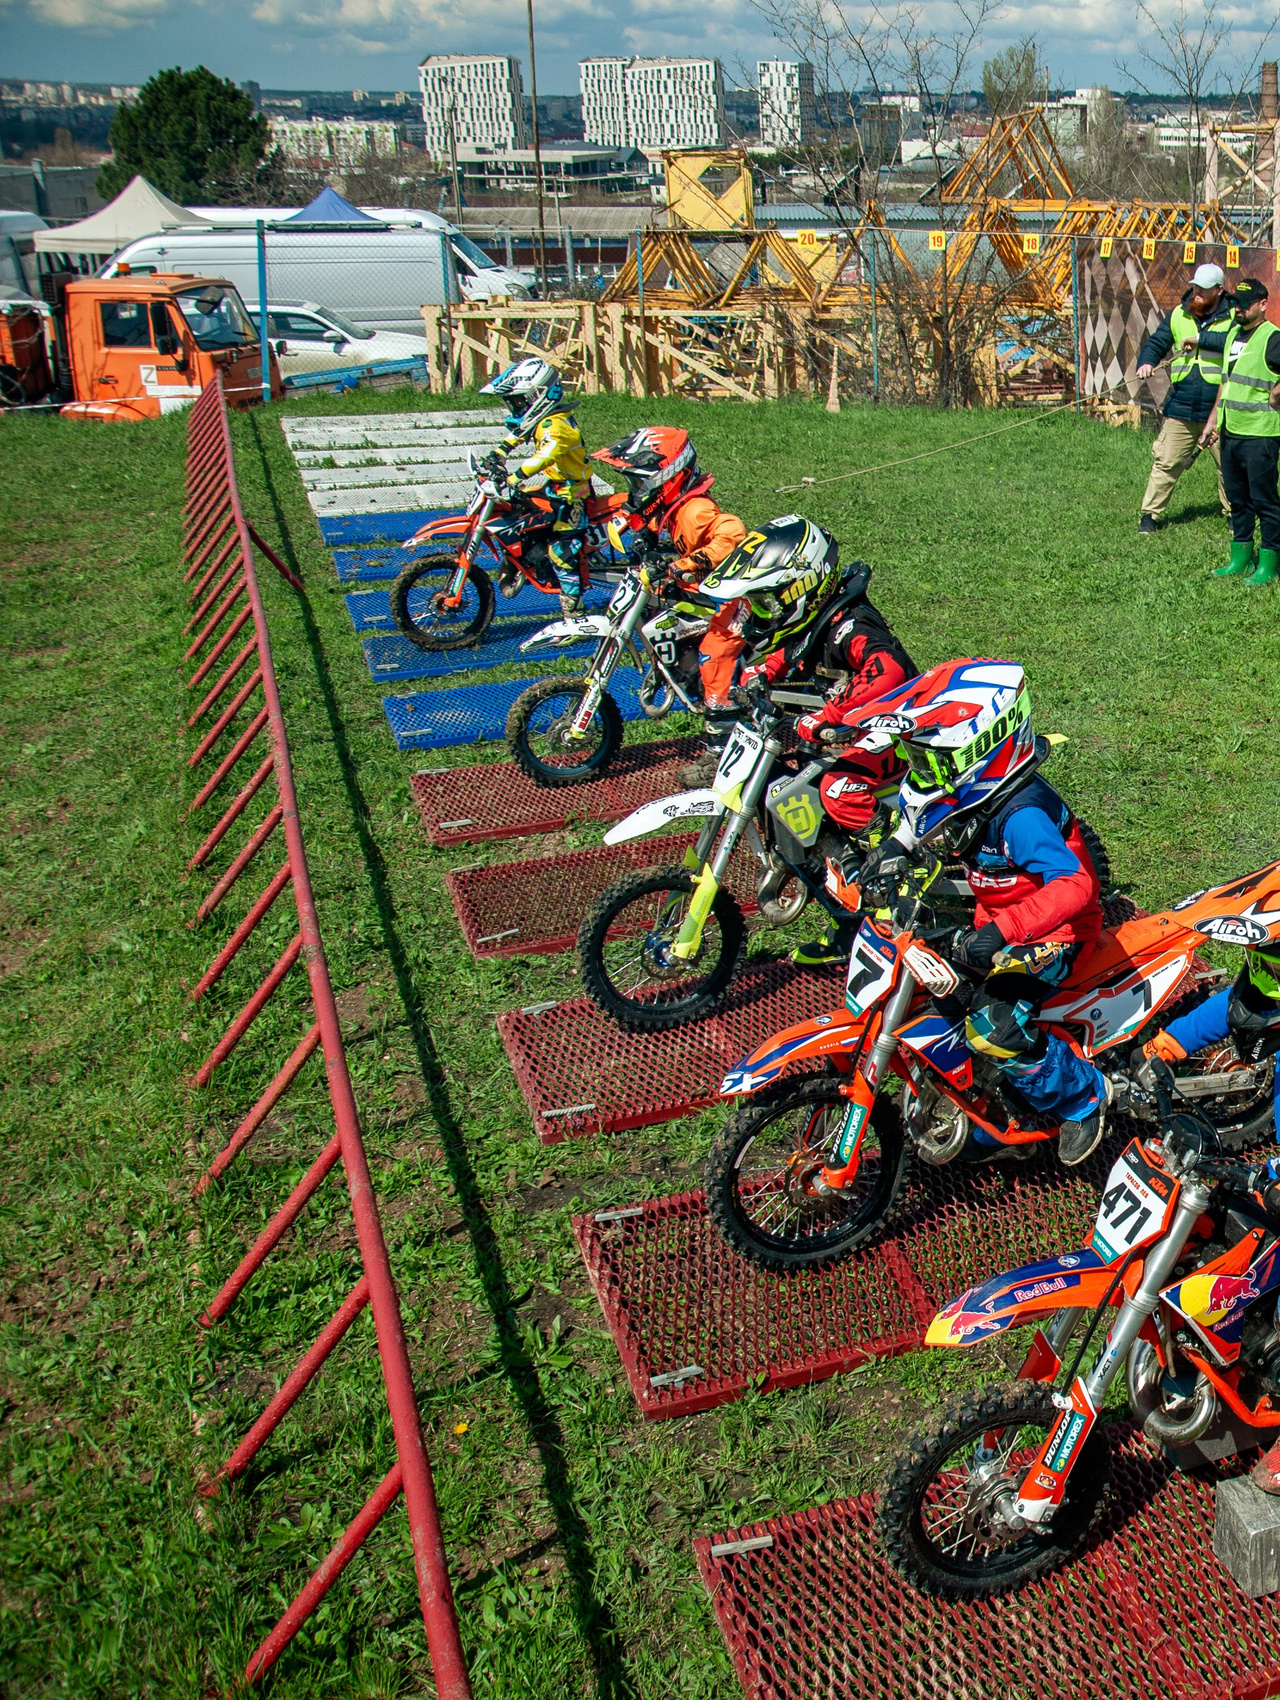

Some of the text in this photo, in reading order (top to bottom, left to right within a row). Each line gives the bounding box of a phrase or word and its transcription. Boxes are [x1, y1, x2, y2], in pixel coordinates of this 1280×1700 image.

[800, 232, 815, 246] 20
[931, 234, 943, 248] 19
[1026, 237, 1037, 250] 18
[1103, 242, 1110, 253] 17
[1145, 244, 1153, 256] 16
[1186, 246, 1194, 260] 15
[1229, 250, 1237, 265] 14
[142, 366, 156, 384] Z
[780, 561, 831, 605] 100%
[863, 713, 910, 730] Airoh
[960, 702, 1023, 767] 100%
[719, 739, 746, 778] 12
[1201, 917, 1261, 939] Airoh
[879, 945, 894, 960] KTM
[847, 946, 885, 999] 7
[1131, 978, 1152, 1012] 7
[819, 1041, 839, 1050] RUSSIA
[952, 1064, 965, 1075] KTM
[845, 1107, 862, 1146] MOTOREX
[1148, 1177, 1169, 1197] KTM
[1102, 1182, 1153, 1245] 471
[1013, 1277, 1067, 1303] Red Bull
[1098, 1359, 1112, 1380] XACT
[1060, 1417, 1085, 1459] MOTOREX
